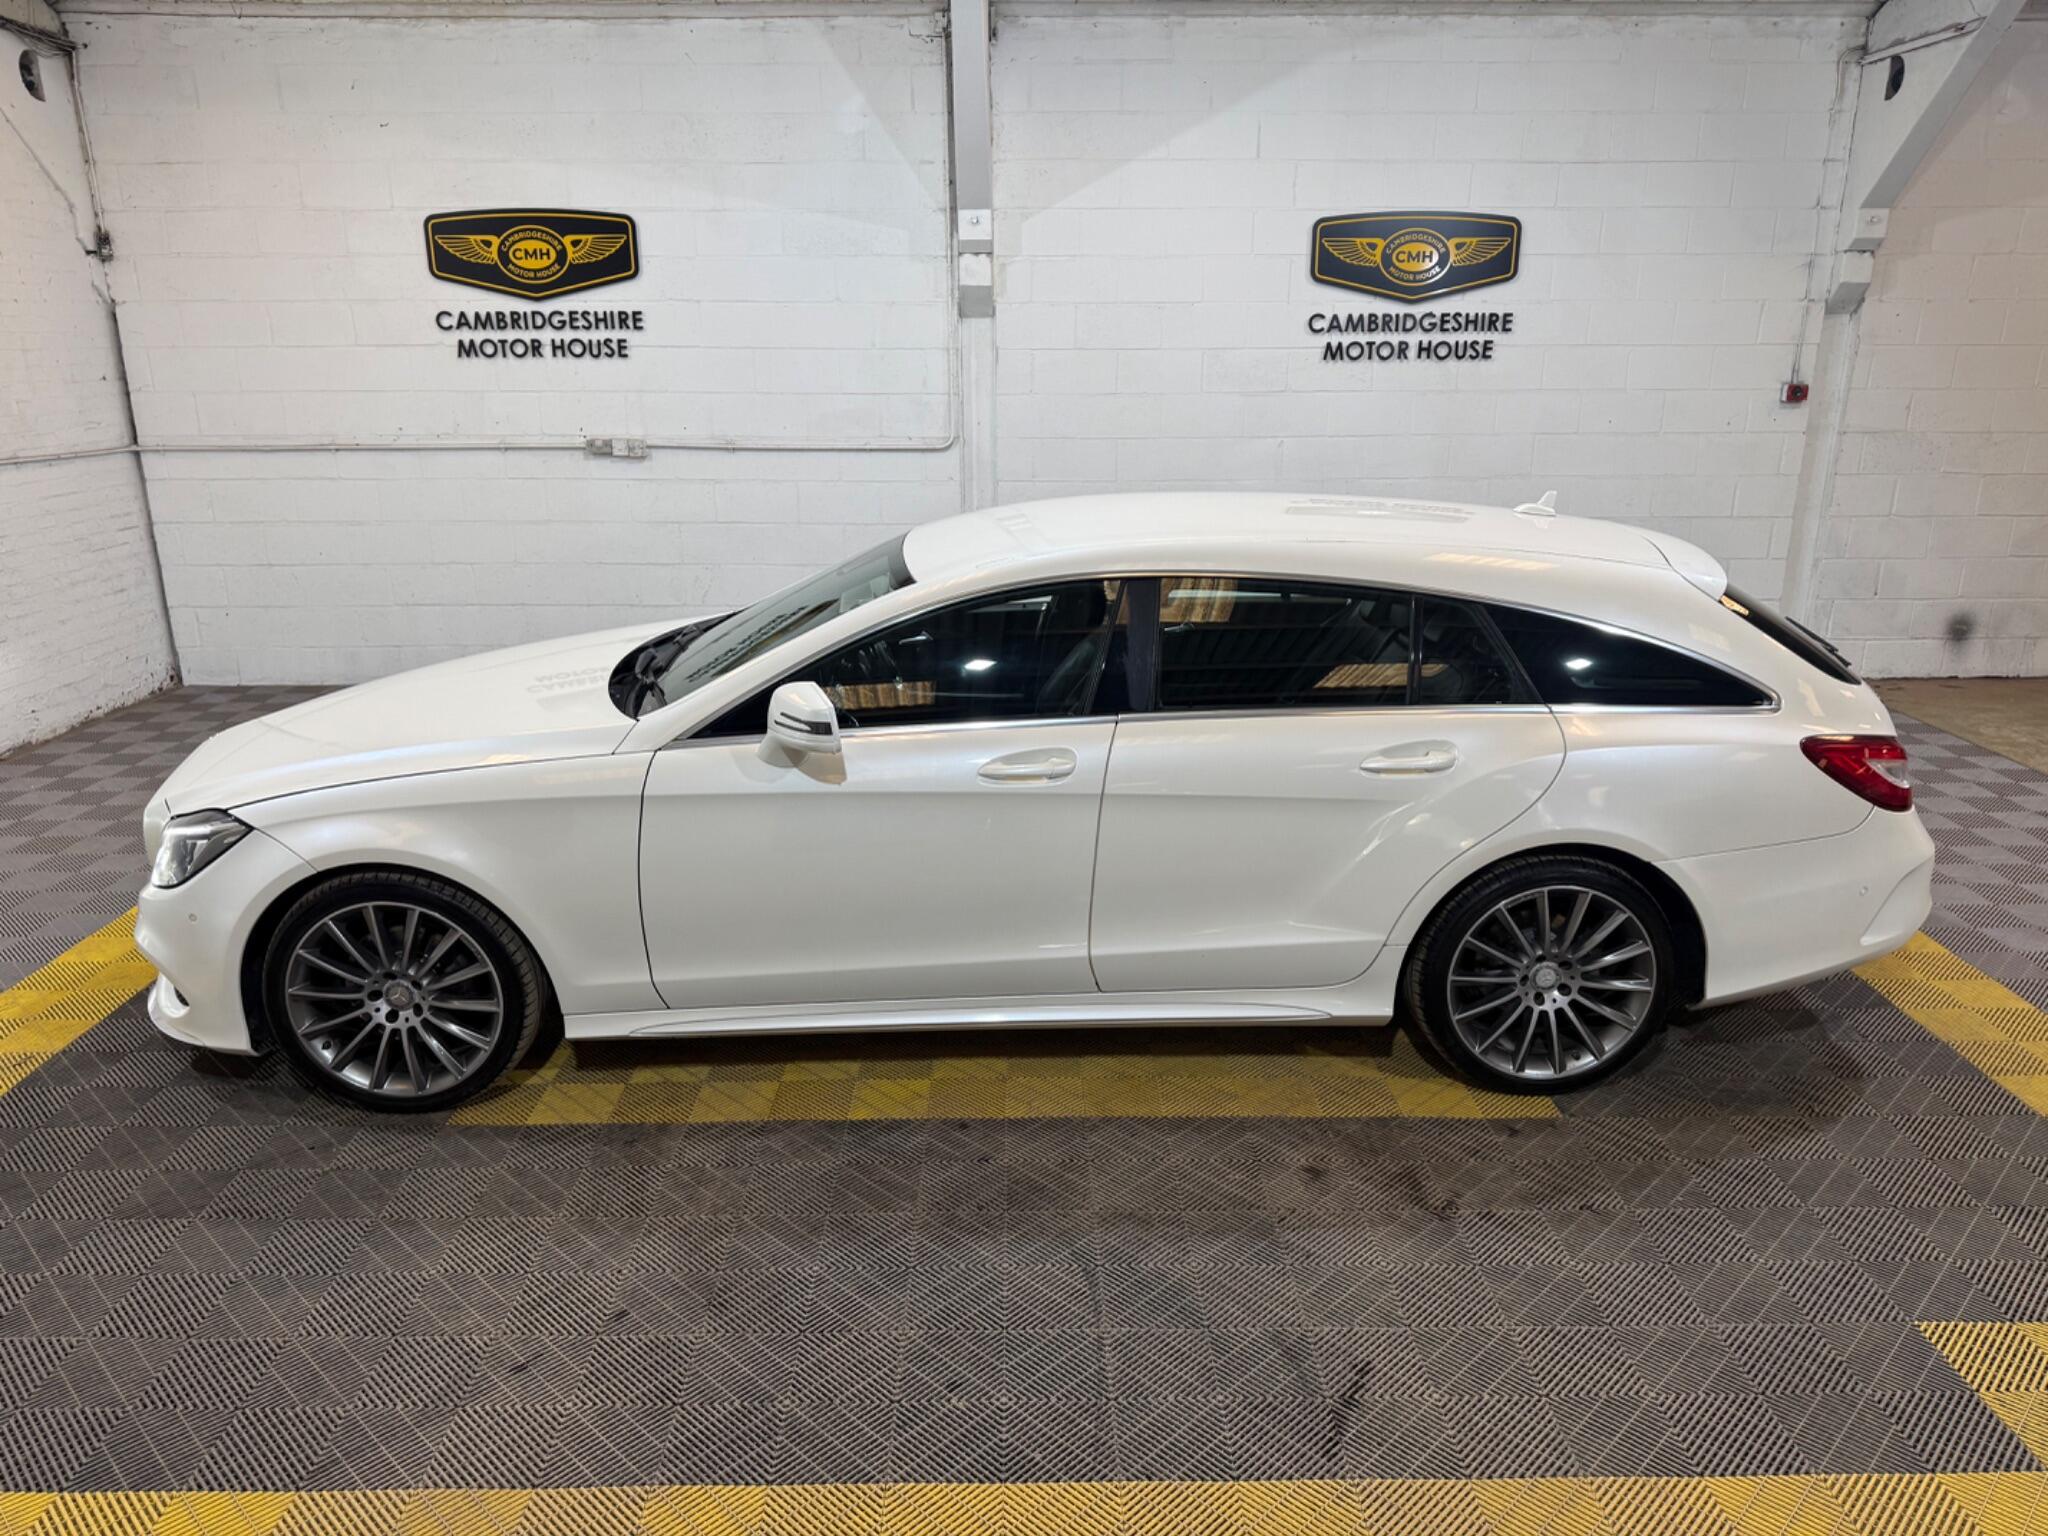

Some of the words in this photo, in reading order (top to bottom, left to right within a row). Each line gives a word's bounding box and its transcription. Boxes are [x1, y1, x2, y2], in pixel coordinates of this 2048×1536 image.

[502, 230, 563, 252] CAMBRIDGESHIRE
[1386, 233, 1446, 254] CAMBRIDGESHIRE
[512, 247, 551, 261] CMH
[1395, 250, 1434, 264] CMH
[508, 263, 535, 278] MOTOR
[536, 263, 560, 278] HOUSE
[1389, 266, 1415, 281] MOTOR
[1416, 265, 1442, 281] HOUSE
[435, 310, 644, 331] CAMBRIDGESHIRE
[1308, 312, 1514, 334] CAMBRIDGESHIRE
[457, 339, 544, 359] MOTOR
[552, 338, 629, 359] HOUSE
[1323, 341, 1409, 361] MOTOR
[1417, 340, 1494, 361] HOUSE
